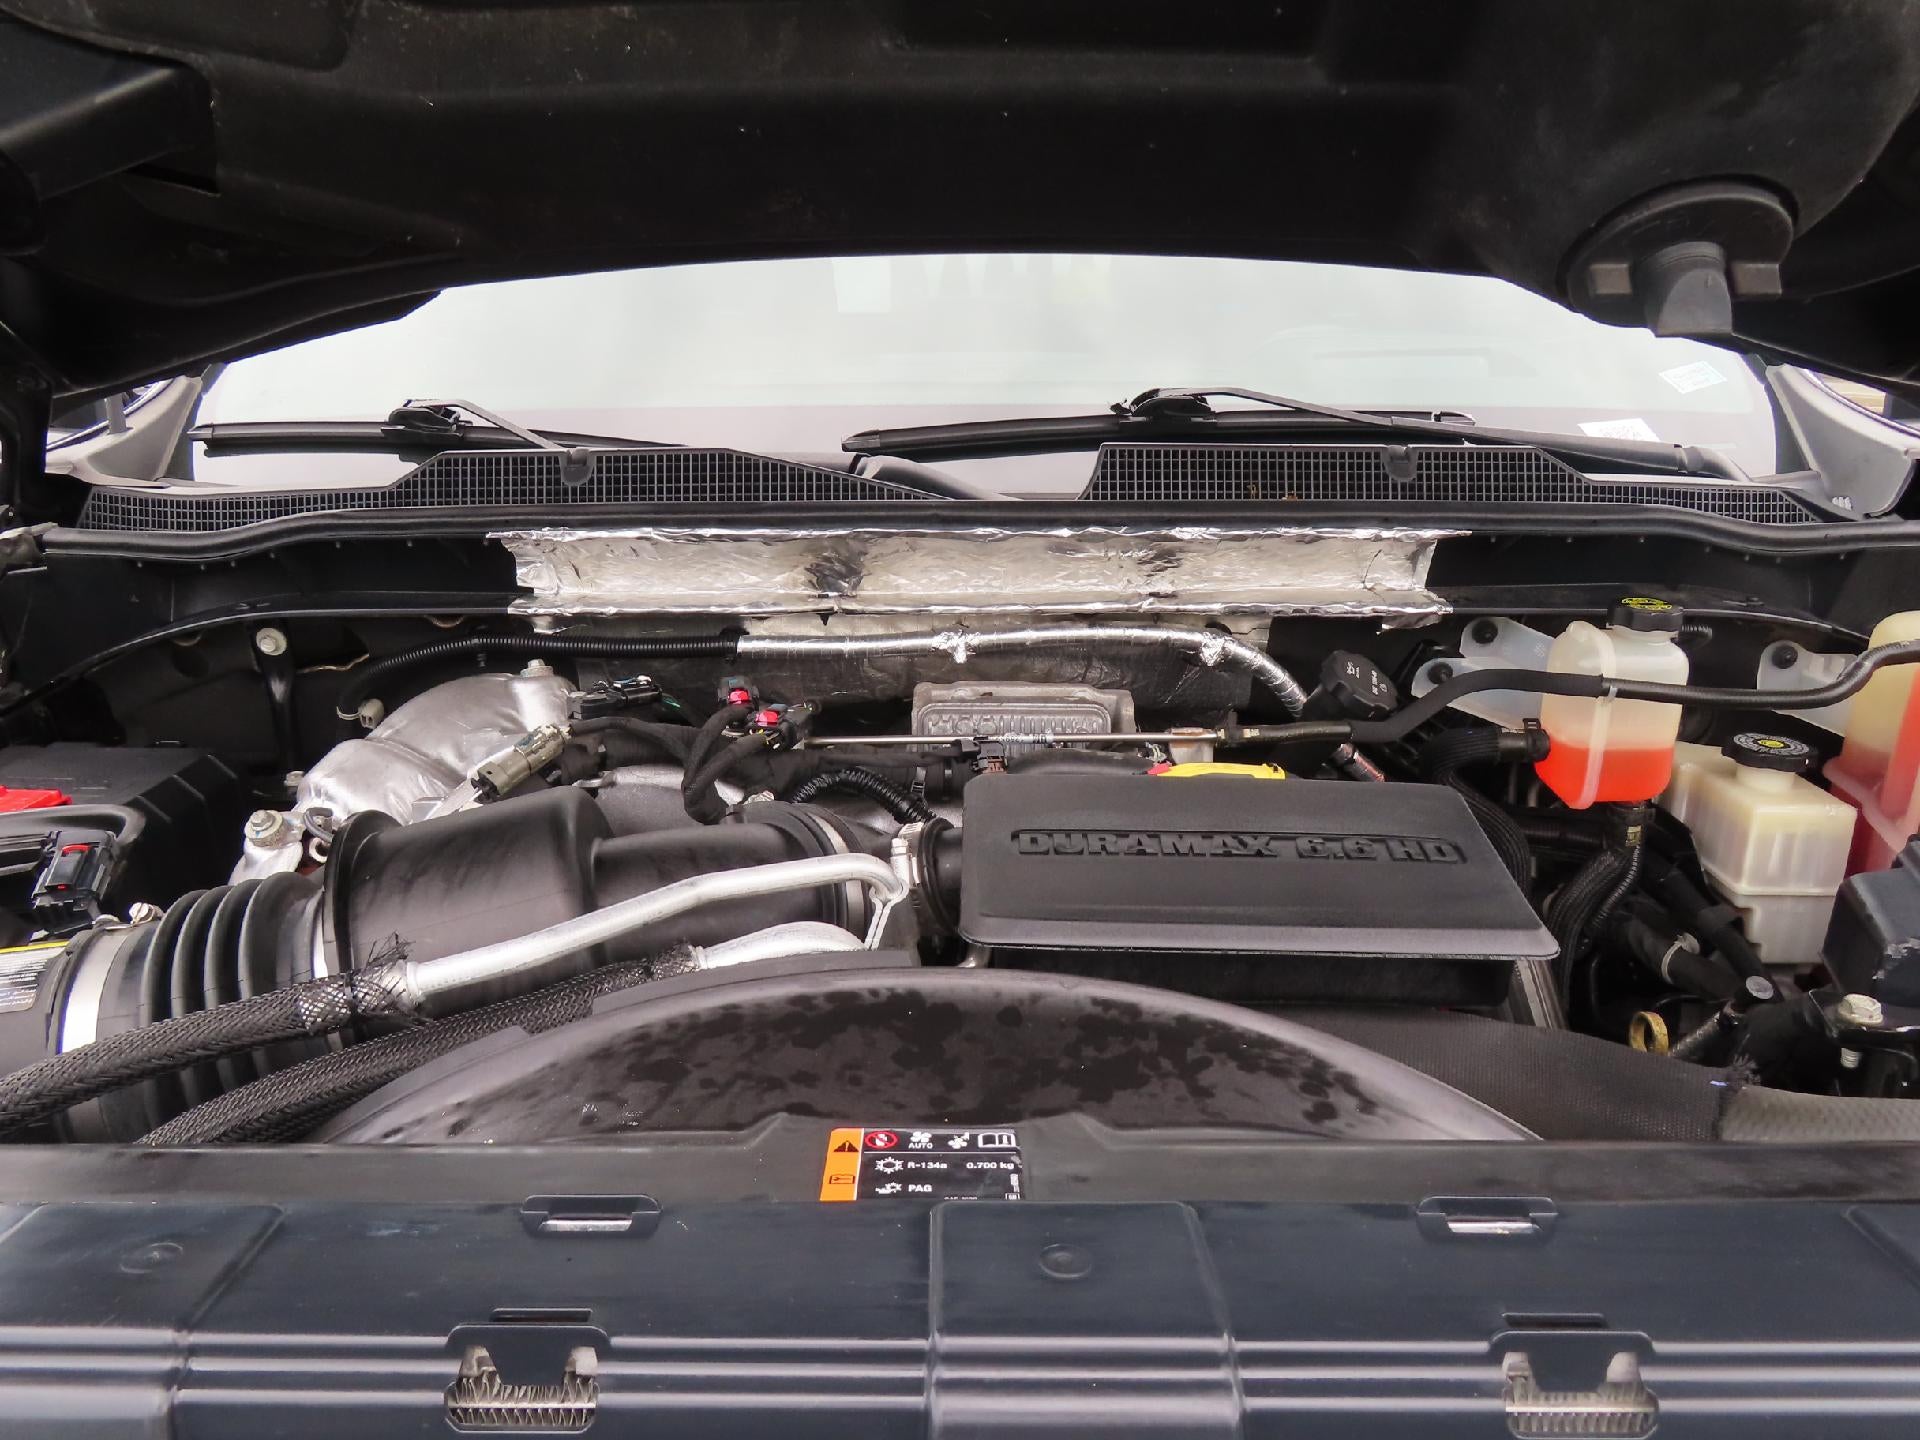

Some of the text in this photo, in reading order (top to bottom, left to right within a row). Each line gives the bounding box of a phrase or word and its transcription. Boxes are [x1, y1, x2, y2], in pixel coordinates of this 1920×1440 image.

[1018, 832, 1466, 864] DURAMAX 6.6 HD
[908, 1142, 933, 1150] AUTO
[907, 1161, 1015, 1171] R-134a 0.700 kg
[908, 1184, 933, 1193] PAG
